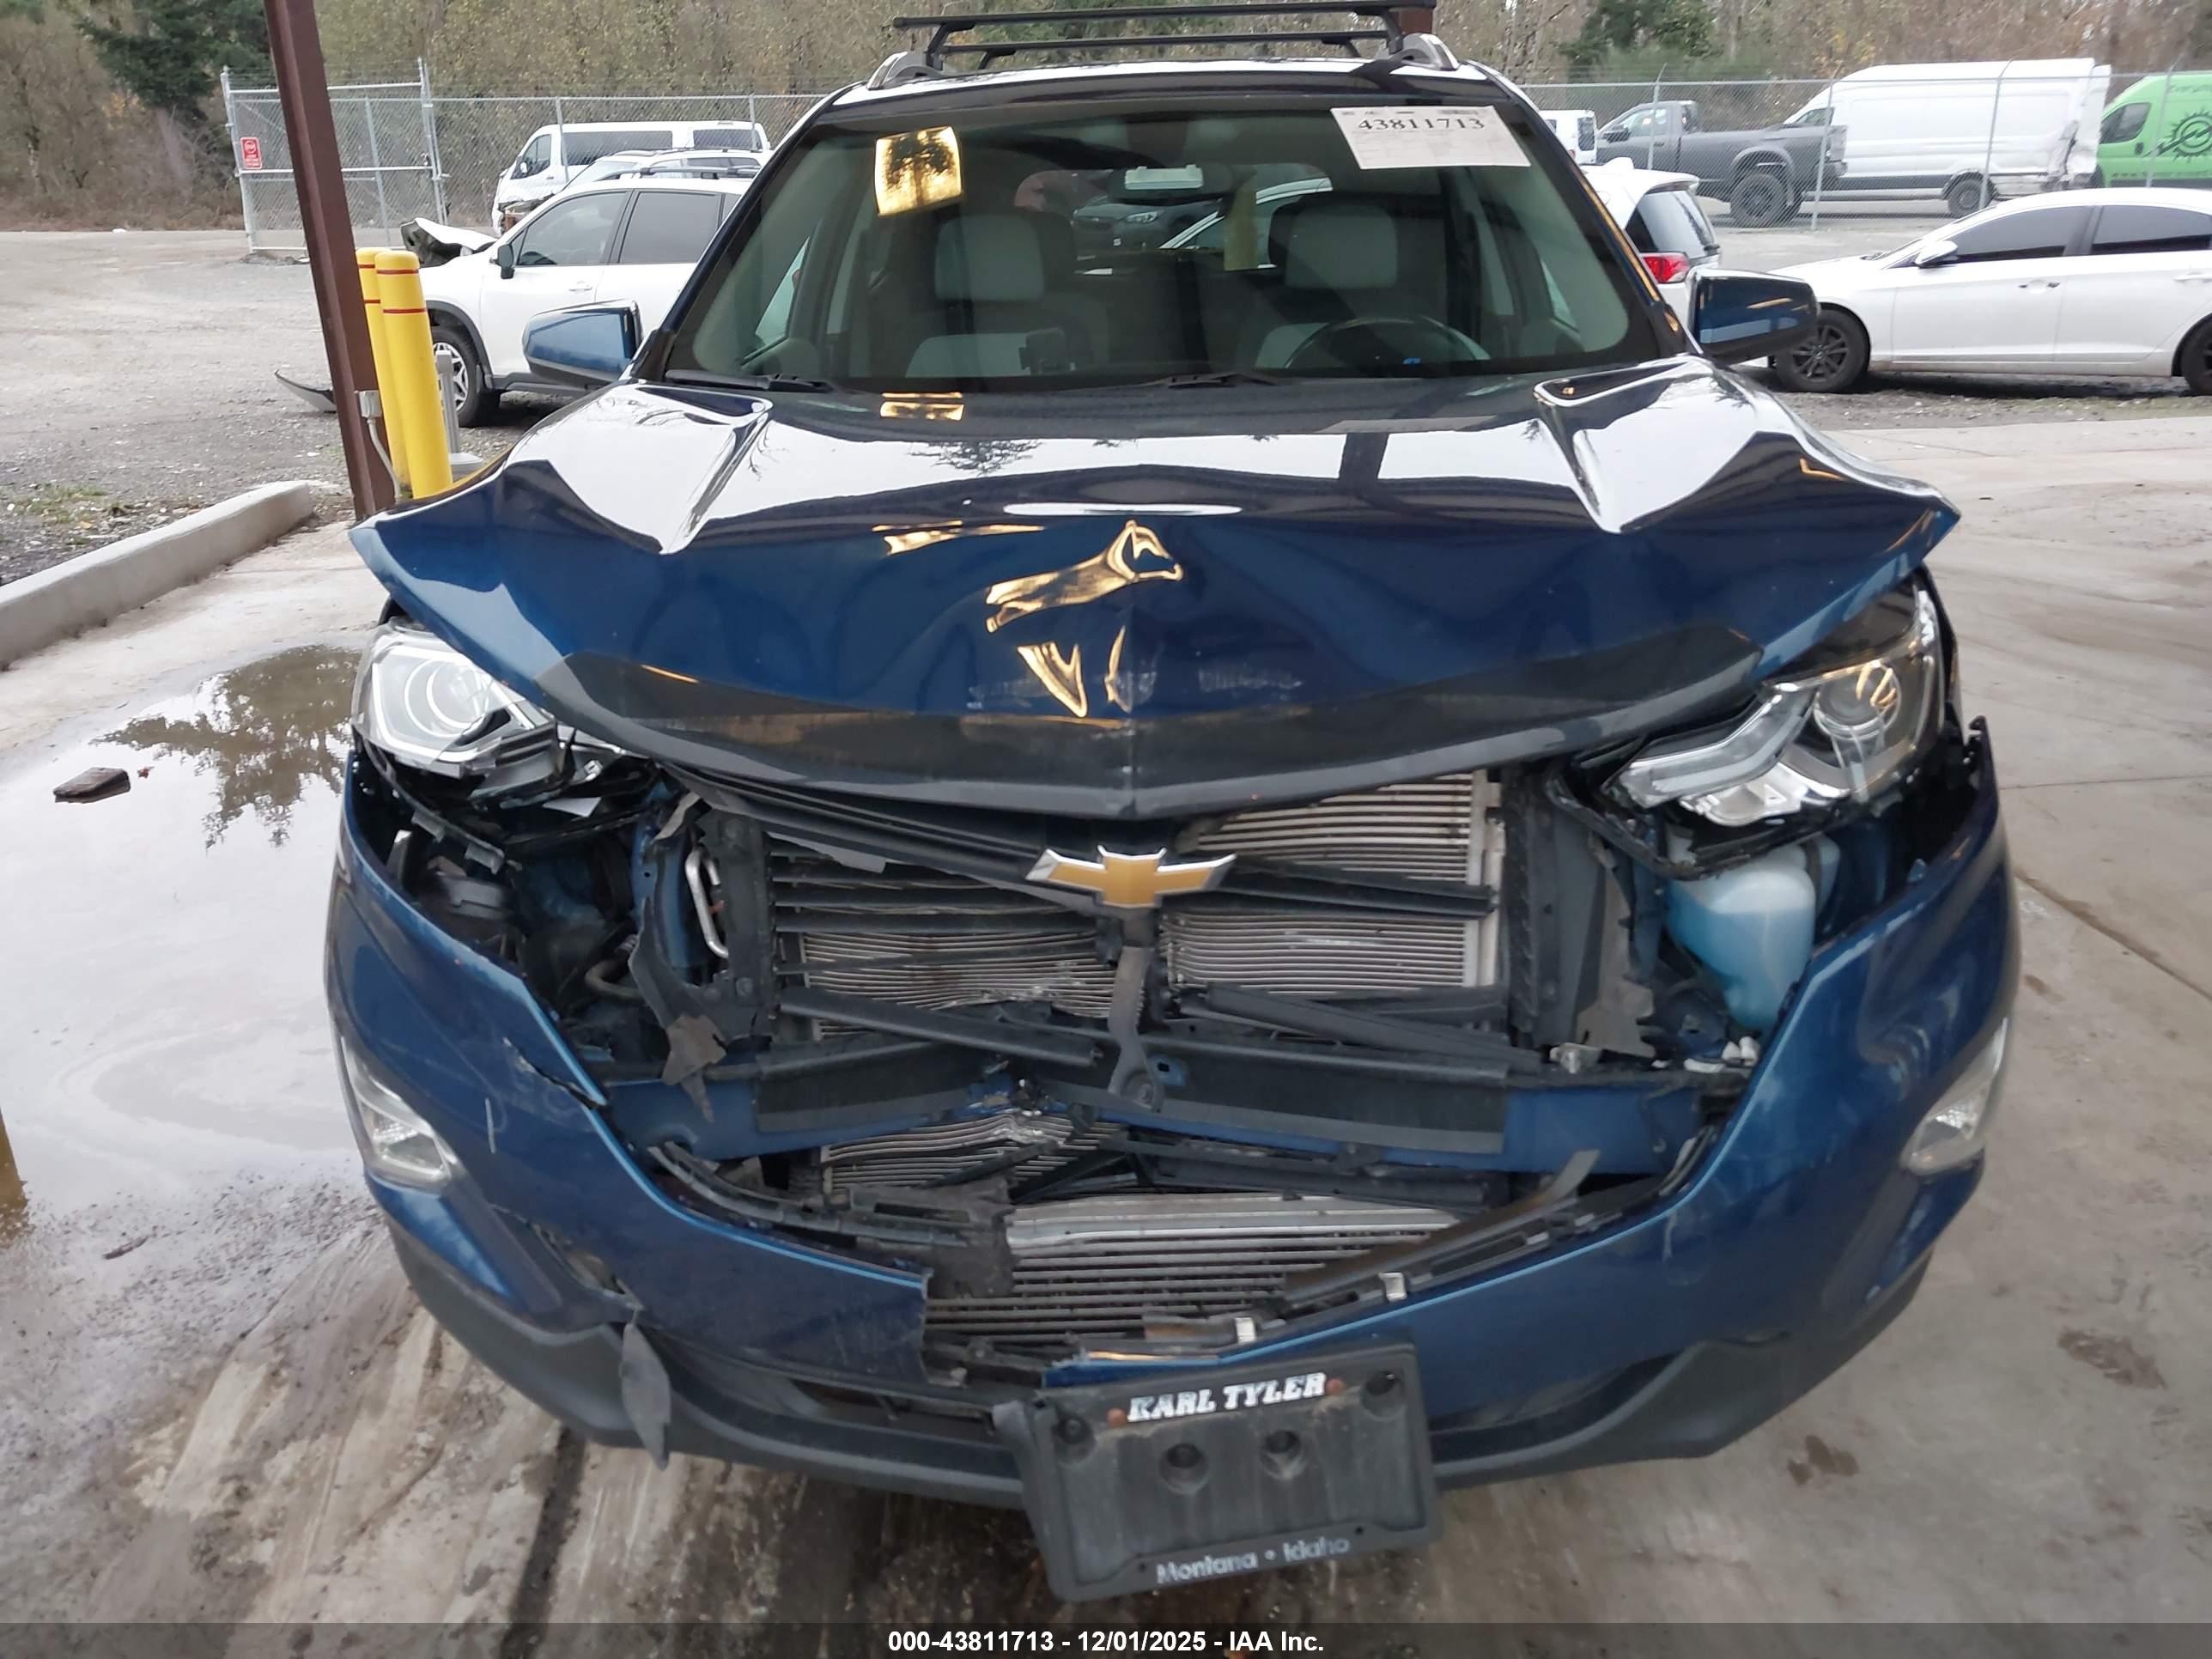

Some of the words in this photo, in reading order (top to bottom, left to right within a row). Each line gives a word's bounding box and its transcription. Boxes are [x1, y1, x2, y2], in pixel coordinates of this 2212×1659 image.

[1358, 118, 1485, 130] 43811713
[1127, 1389, 1217, 1423] KARL
[1223, 1371, 1327, 1410] TYLER
[1157, 1553, 1258, 1584] Montana
[1283, 1536, 1351, 1562] Idaho
